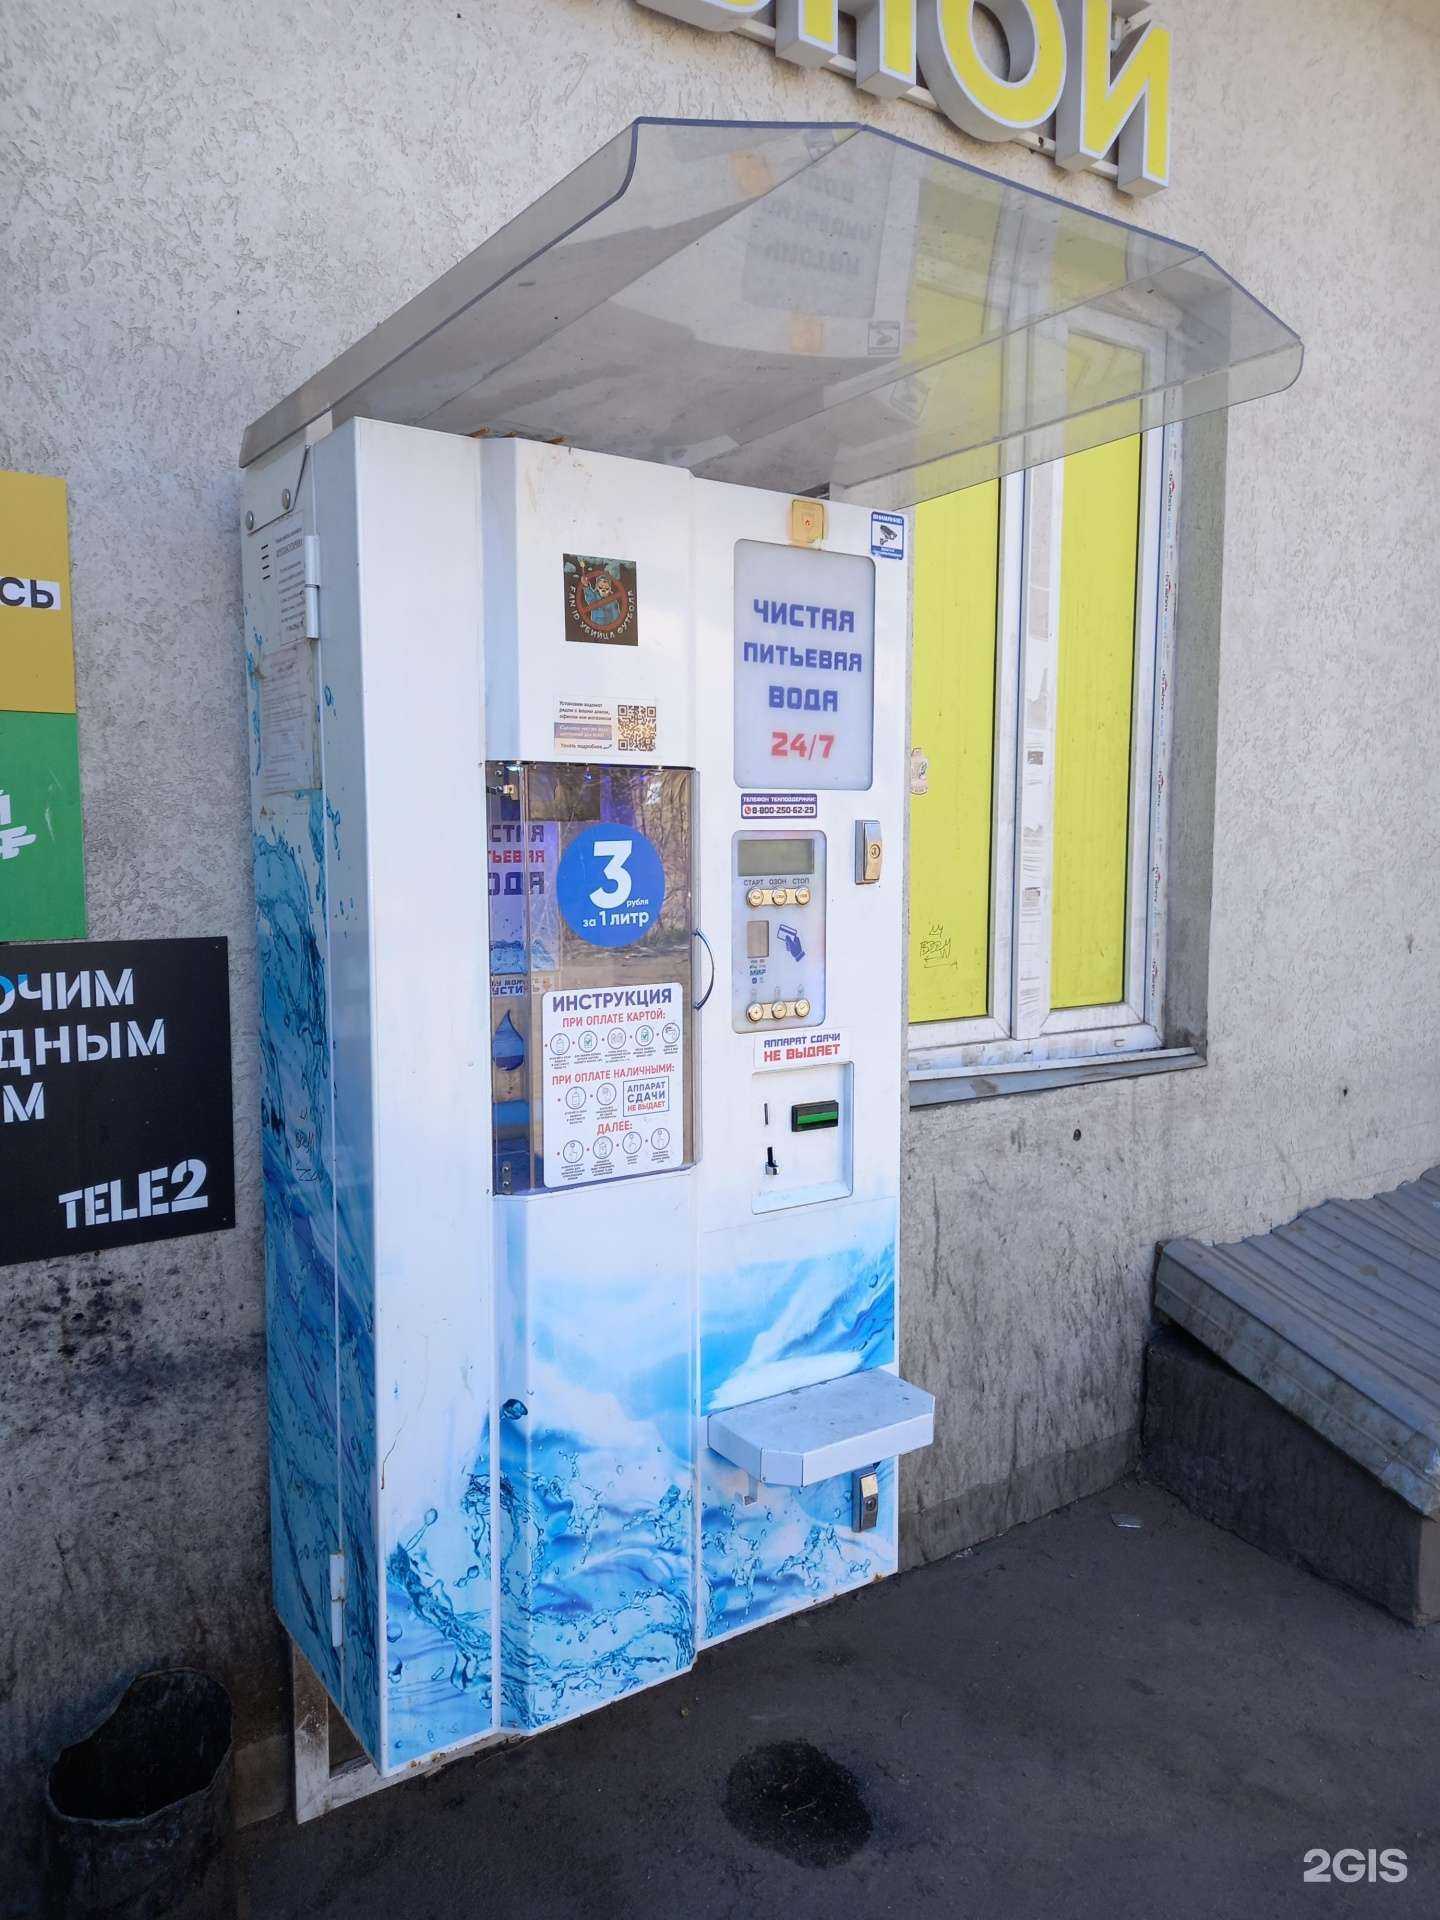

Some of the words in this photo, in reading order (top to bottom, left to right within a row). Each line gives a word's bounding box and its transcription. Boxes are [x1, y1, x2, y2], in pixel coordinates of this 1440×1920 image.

[754, 599, 854, 632] ЧИСТАЯ
[744, 641, 862, 672] ПИТЬЕВАЯ
[769, 685, 838, 712] ВОДА
[771, 731, 835, 760] 24/7
[589, 840, 632, 909] 3
[626, 898, 649, 908] рубля
[582, 919, 596, 927] за
[599, 910, 606, 926] 1
[610, 911, 649, 927] литр
[553, 988, 672, 1012] ИНСТРУКЦИЯ
[562, 1017, 583, 1028] ПРИ
[586, 1013, 624, 1026] ОПЛАТЕ
[627, 1008, 666, 1022] КАРТОЙ:
[764, 1036, 807, 1048] АППАРАТ
[810, 1033, 840, 1043] СДАЧИ
[764, 1050, 781, 1062] НЕ
[786, 1044, 840, 1060] ВЫДАЕТ
[552, 1075, 572, 1086] ПРИ
[574, 1070, 611, 1083] ОПЛАТЕ
[613, 1063, 675, 1079] НАЛИЧНЫМИ:
[627, 1081, 666, 1093] АППАРАТ
[627, 1091, 665, 1103] СДАЧИ
[627, 1103, 637, 1112] НЕ
[638, 1100, 666, 1111] ВЫДАЕТ
[597, 1120, 633, 1136] ДАЛЕЕ:
[58, 1159, 208, 1229] TELE2
